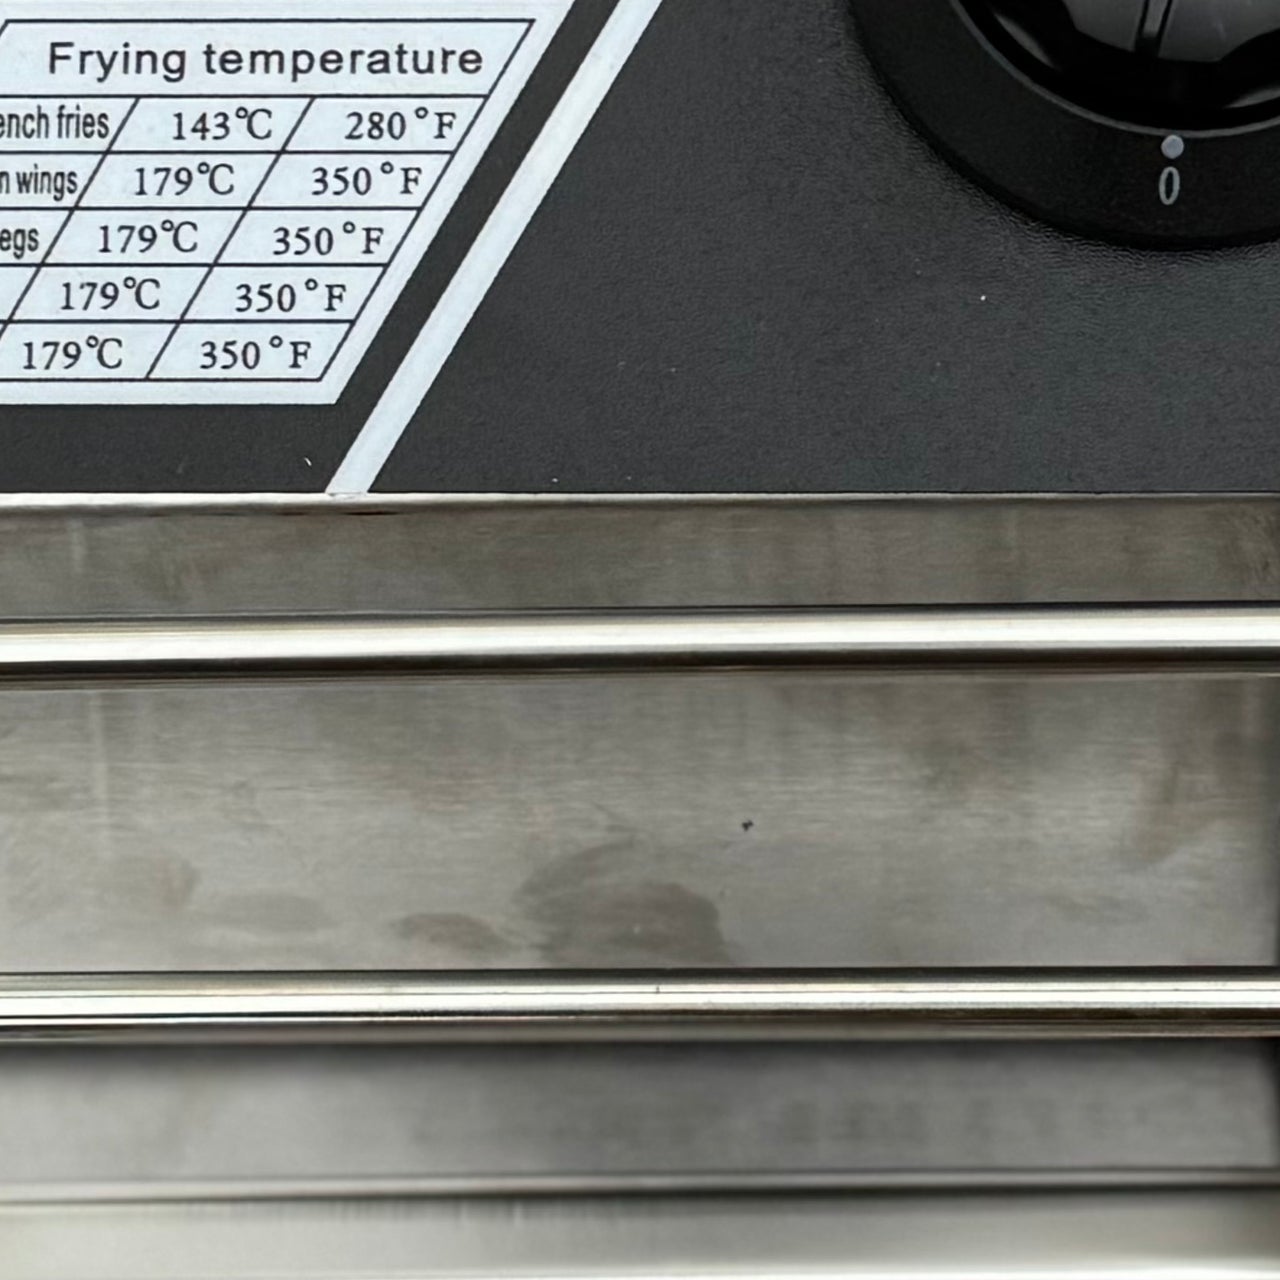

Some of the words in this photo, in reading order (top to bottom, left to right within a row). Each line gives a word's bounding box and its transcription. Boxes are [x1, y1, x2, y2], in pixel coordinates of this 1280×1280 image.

[49, 41, 187, 83] Frying
[203, 42, 484, 83] temperature
[56, 104, 110, 140] fries
[16, 164, 79, 202] wings
[1158, 166, 1181, 206] 0
